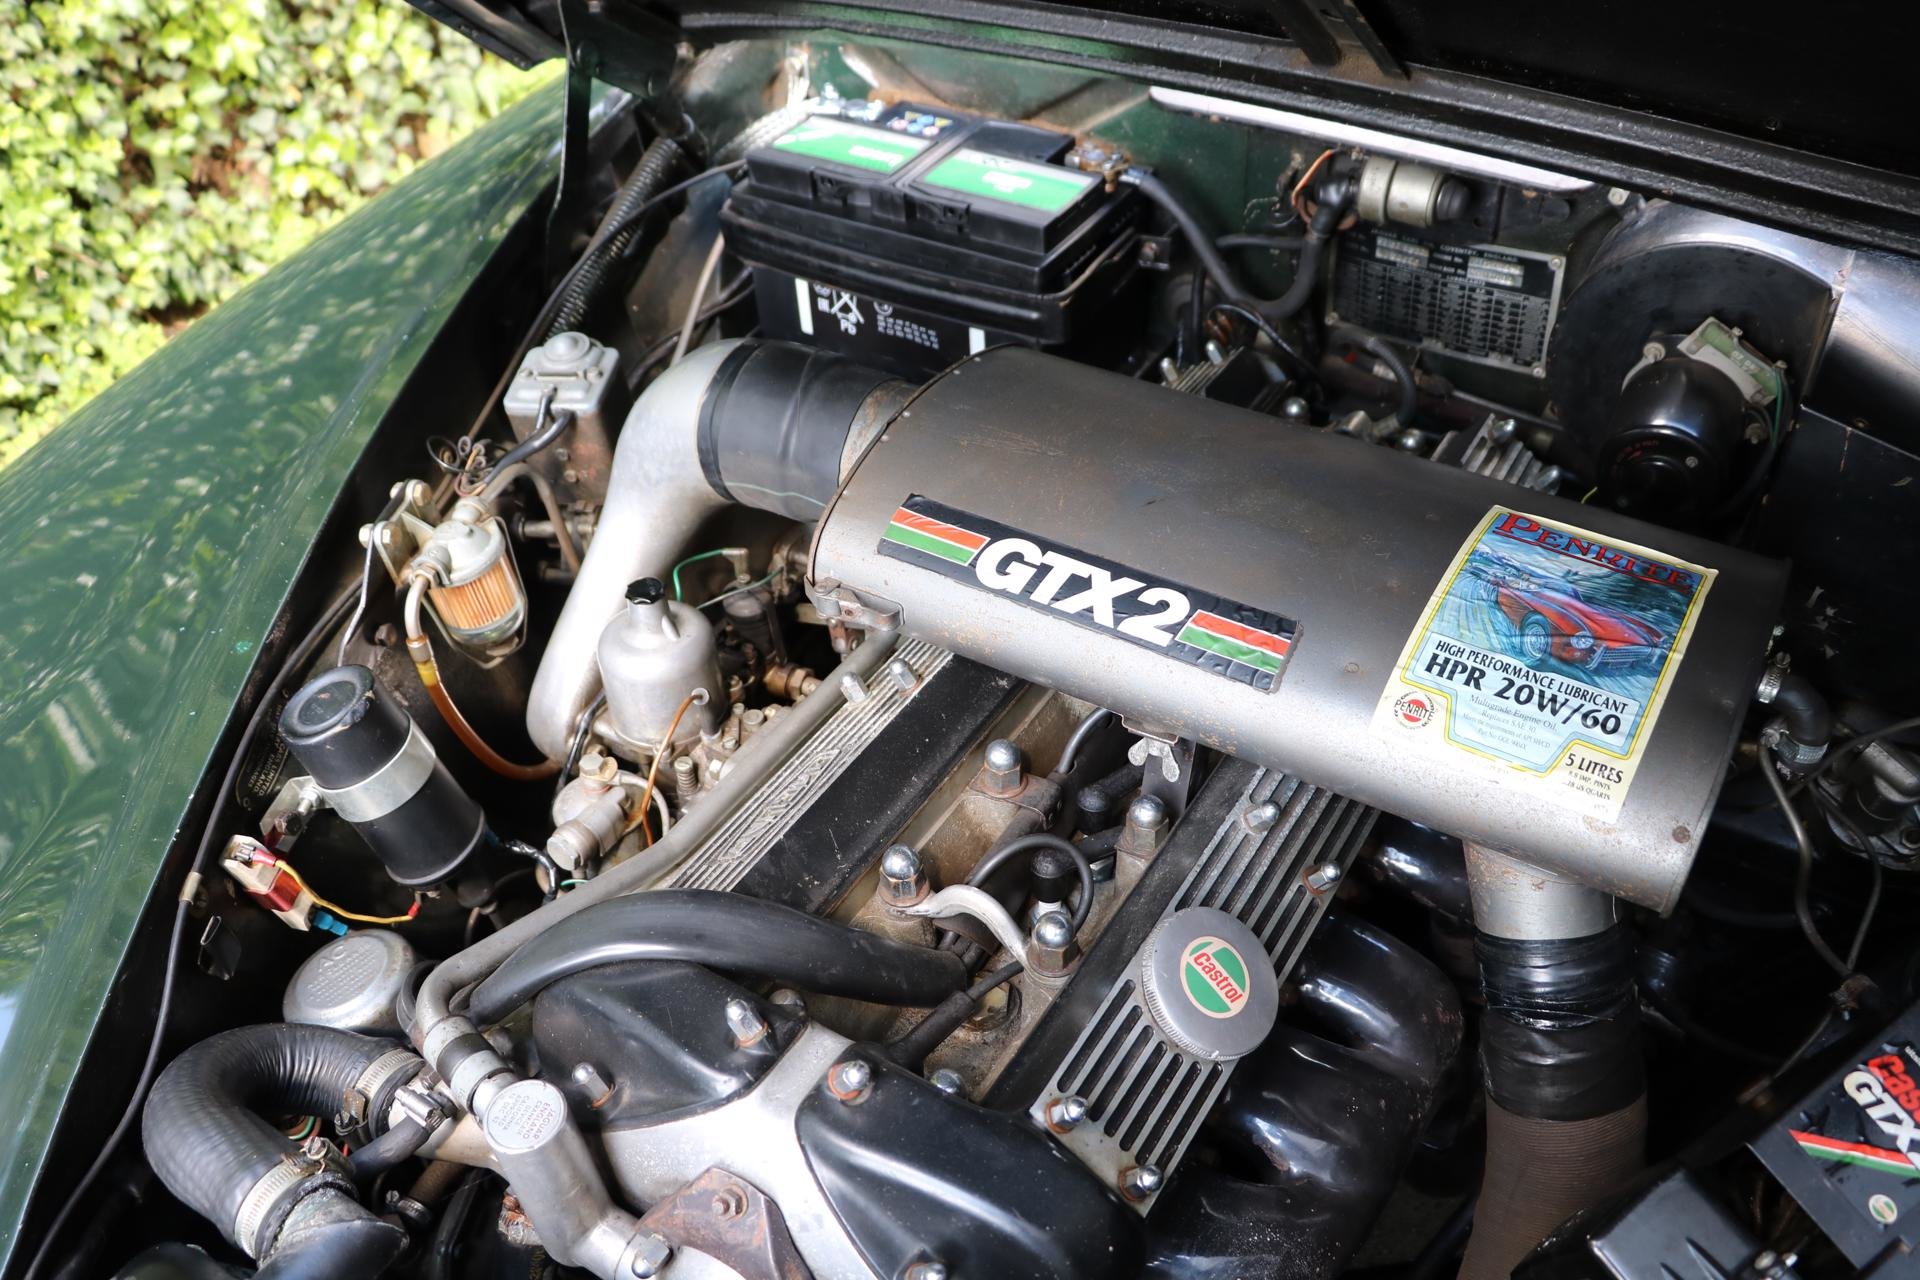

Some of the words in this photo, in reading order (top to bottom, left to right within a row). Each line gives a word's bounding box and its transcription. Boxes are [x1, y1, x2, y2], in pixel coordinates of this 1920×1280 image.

[1496, 512, 1693, 588] PENRITE
[975, 538, 1191, 647] GTX2
[1394, 699, 1435, 722] PENRITE
[1425, 653, 1487, 691] HPR
[1494, 677, 1622, 735] 20W/60
[1435, 640, 1466, 659] HIGH
[1467, 648, 1556, 690] PERFORMANCE
[1557, 682, 1629, 714] LUBRICANT
[1565, 752, 1576, 767] 5
[1578, 757, 1624, 784] LITRES
[1193, 952, 1244, 1004] Castrol
